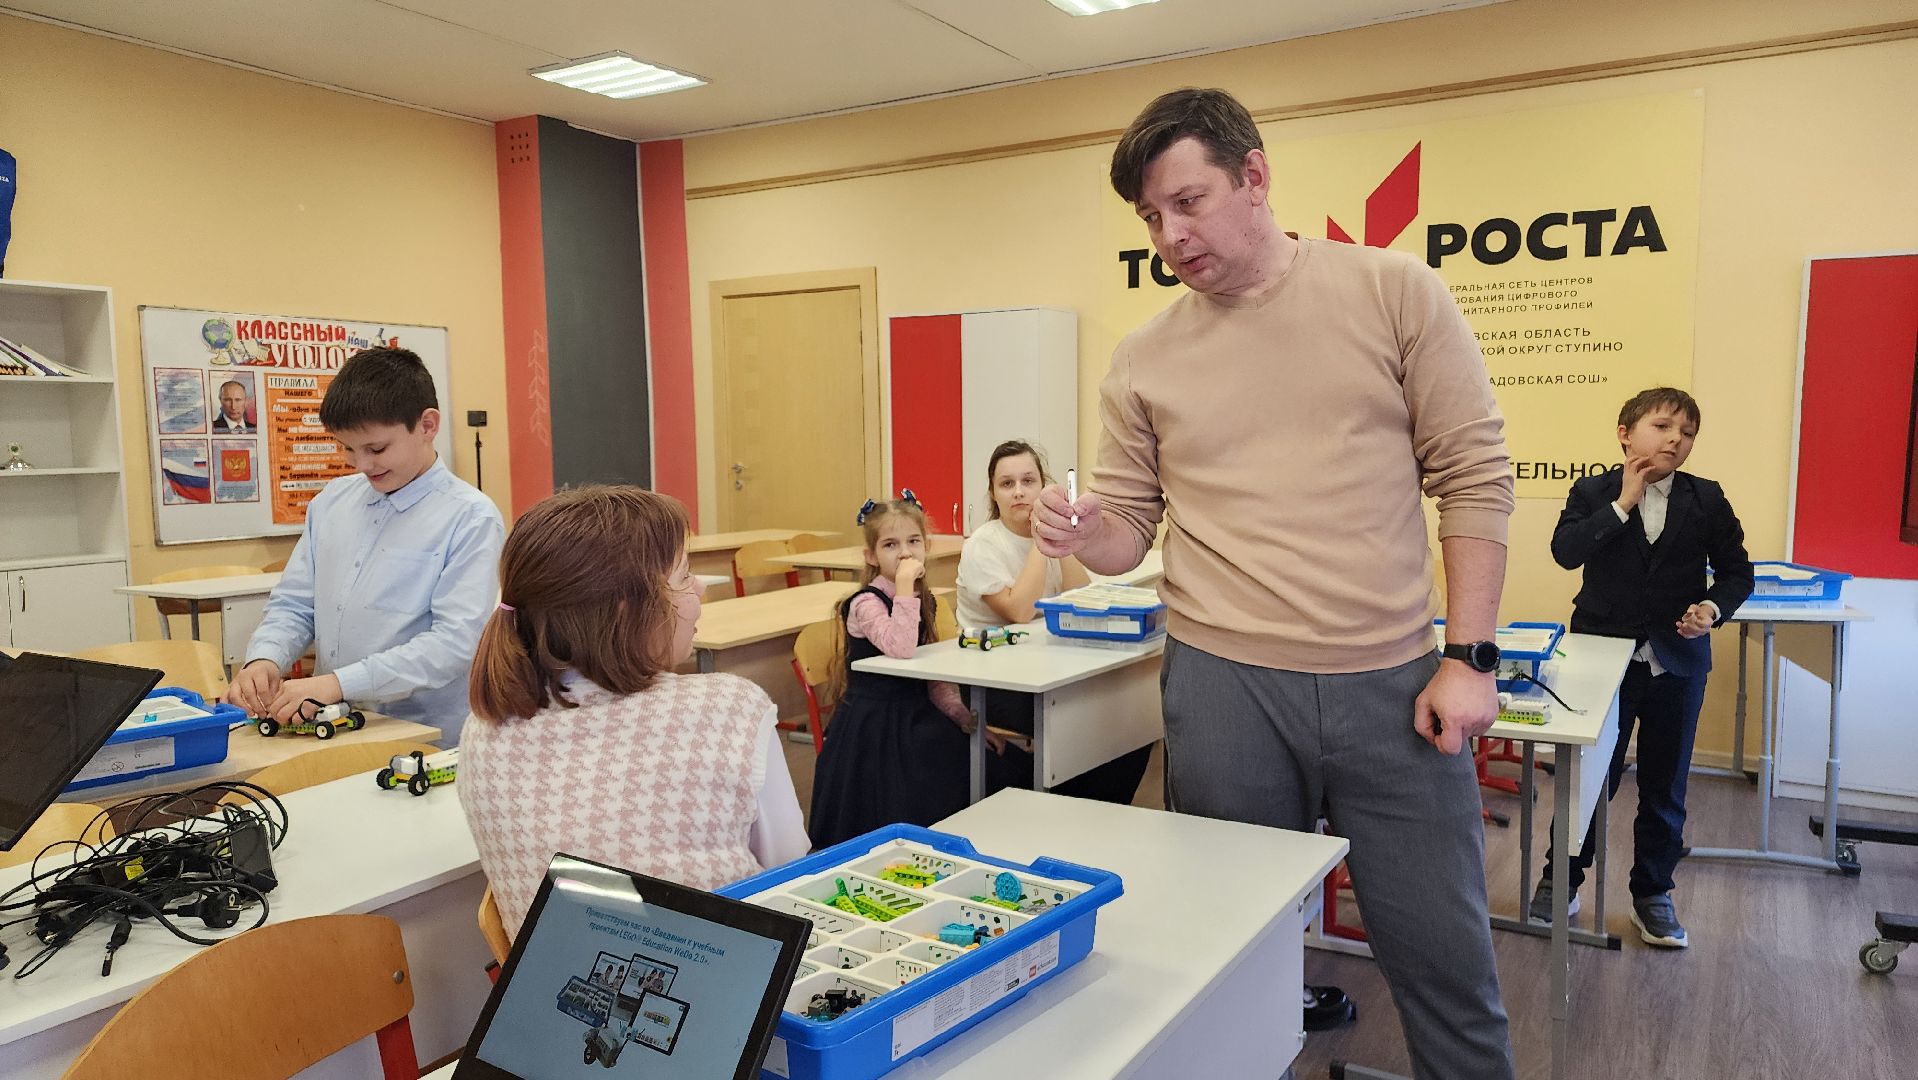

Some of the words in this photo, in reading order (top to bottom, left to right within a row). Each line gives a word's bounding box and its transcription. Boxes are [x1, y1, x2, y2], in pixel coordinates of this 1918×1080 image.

[1118, 248, 1182, 289] ТО
[1426, 205, 1668, 268] РОСТА
[1449, 282, 1505, 293] ЕРАЛЬНАЯ
[1508, 280, 1537, 289] СЕТЬ
[1540, 277, 1593, 288] ЦЕНТРОВ
[1455, 294, 1504, 305] ЗОВАНИЯ
[1507, 290, 1578, 302] ЦИФРОВОГО
[1463, 304, 1527, 316] НИТАРНОГО
[1531, 300, 1593, 312] ПРОФИЛЕЙ
[236, 319, 347, 342] КЛАССНЫЙ
[1473, 330, 1517, 341] ВСКАЯ
[1524, 327, 1591, 340] ОБЛАСТЬ
[347, 335, 369, 349] НАШ
[1479, 344, 1505, 356] КОЙ
[1508, 344, 1551, 355] ОКРУГ
[1555, 341, 1624, 354] СТУПИНО
[270, 342, 358, 370] УГОЛО
[270, 377, 316, 388] ПРАВИЛА
[1489, 375, 1563, 387] АДОВСКАЯ
[1567, 374, 1608, 385] СОШ»
[1509, 461, 1624, 481] ЕЛЬНО
